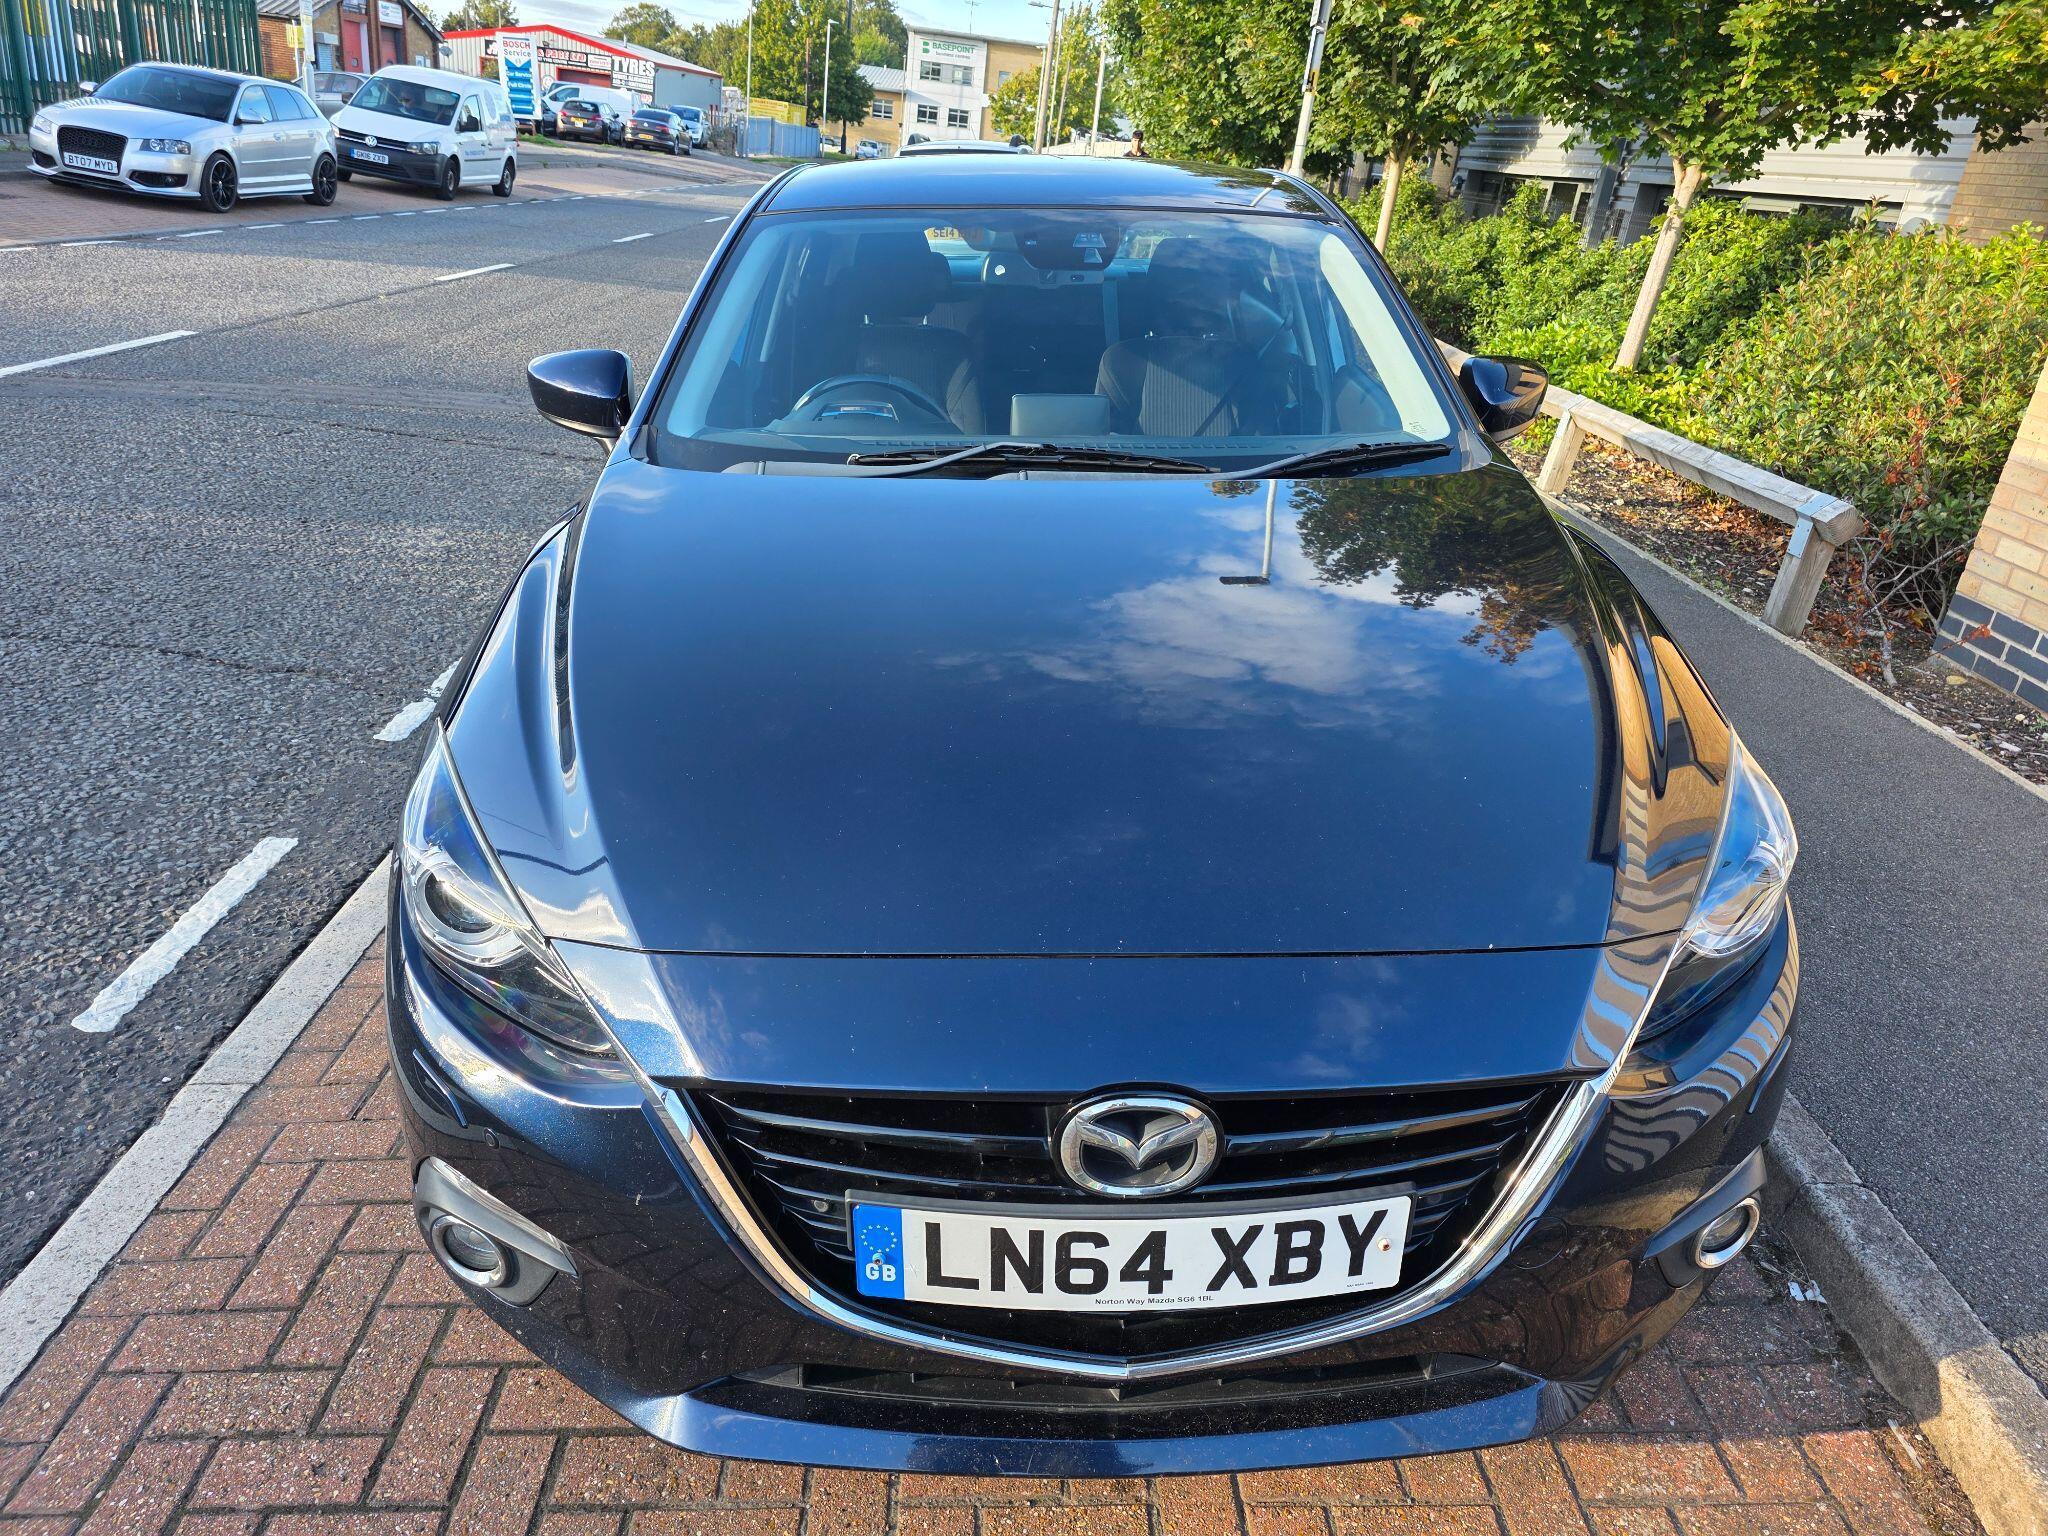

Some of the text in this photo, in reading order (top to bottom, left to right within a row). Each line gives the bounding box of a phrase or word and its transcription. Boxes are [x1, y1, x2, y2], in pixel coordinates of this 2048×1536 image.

[503, 40, 531, 49] BOSCH
[932, 42, 975, 54] BASEPOINT
[504, 48, 532, 57] Service
[612, 55, 656, 77] TYRES
[68, 154, 114, 171] BT07 MYD
[925, 1209, 1389, 1295] LN64 XBY
[865, 1262, 897, 1282] GB
[1126, 1298, 1146, 1306] Way
